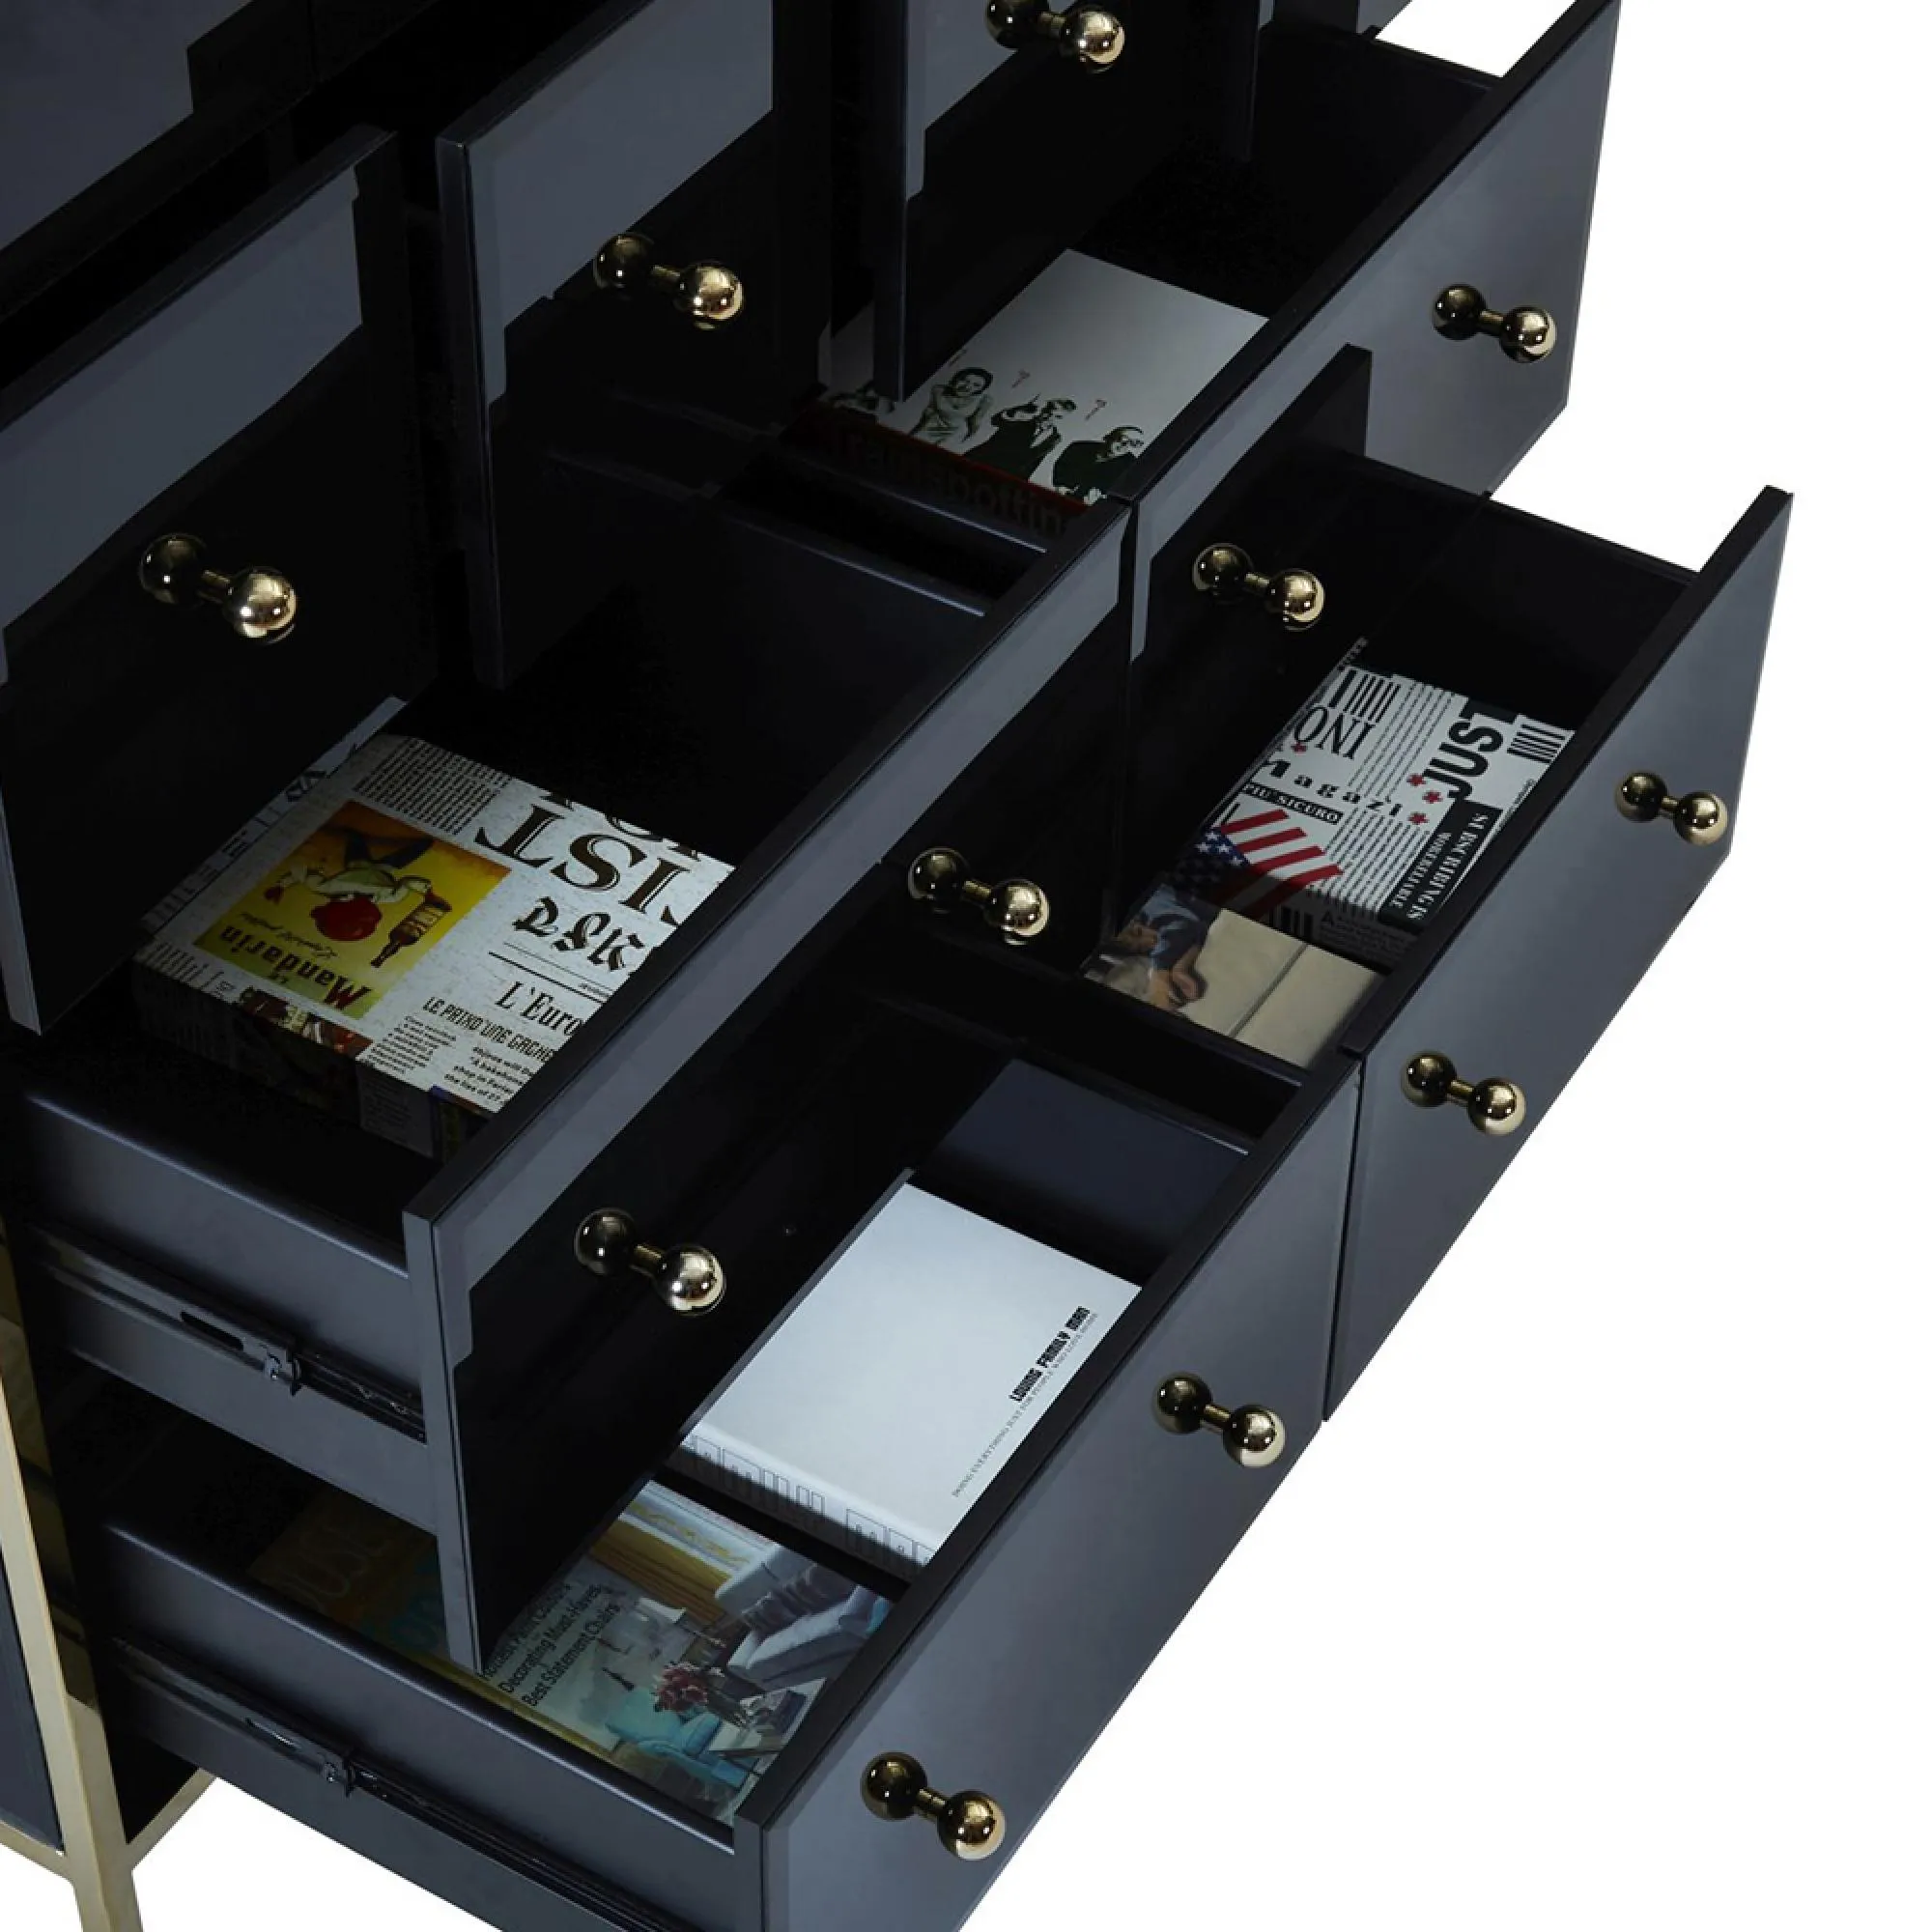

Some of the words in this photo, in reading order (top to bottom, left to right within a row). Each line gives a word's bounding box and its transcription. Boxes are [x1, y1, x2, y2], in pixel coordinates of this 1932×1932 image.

[218, 923, 373, 1010] Mandarin
[1036, 1330, 1070, 1368] FAMILY
[971, 1427, 1009, 1474] EVERYTHING
[497, 1640, 557, 1693] Decorating
[522, 1682, 552, 1707] Best
[541, 1633, 596, 1686] Statement
